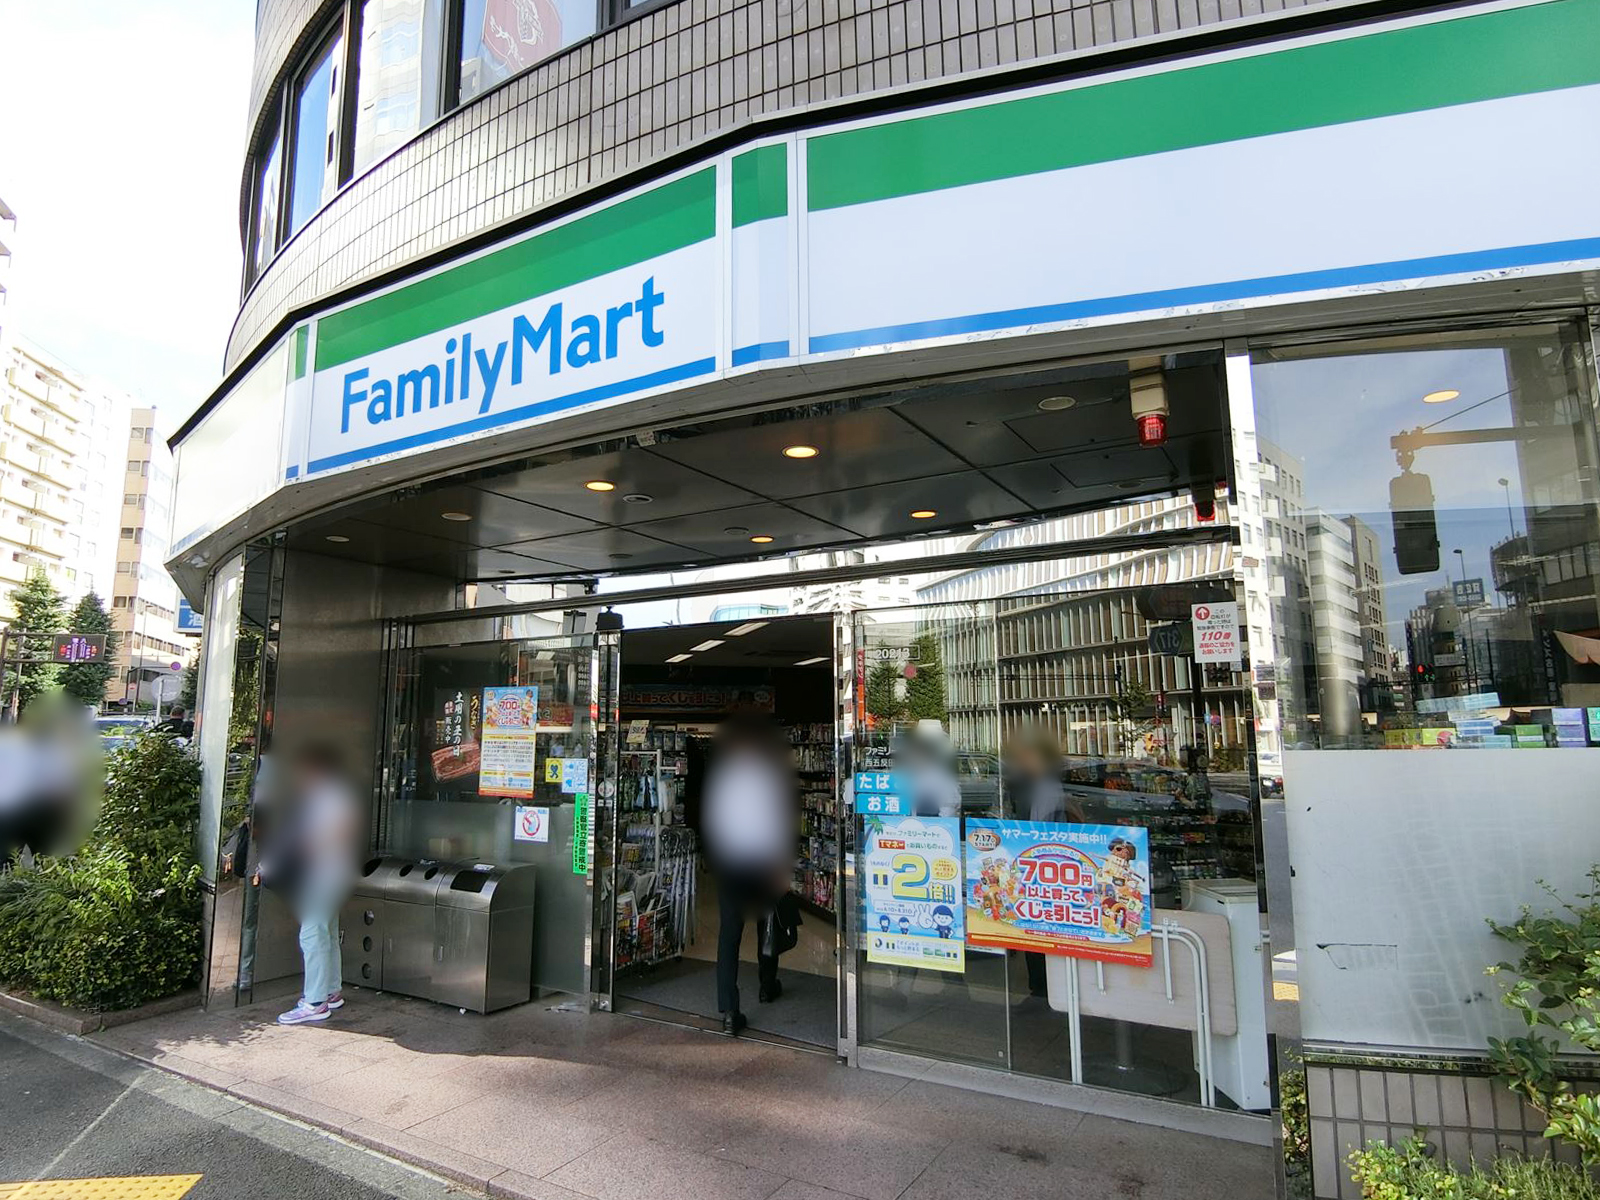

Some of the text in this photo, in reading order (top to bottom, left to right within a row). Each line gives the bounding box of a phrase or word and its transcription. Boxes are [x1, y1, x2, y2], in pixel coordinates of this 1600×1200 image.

[341, 276, 664, 433] FamilyMart
[1201, 631, 1232, 641] 110番
[453, 691, 464, 757] 土用の丑の日
[859, 774, 898, 789] たば
[868, 797, 900, 813] お酒
[1002, 828, 1107, 845] サマーフェスタ実施中!!
[1018, 858, 1093, 887] 700円
[1015, 901, 1099, 926] くじを引こう!
